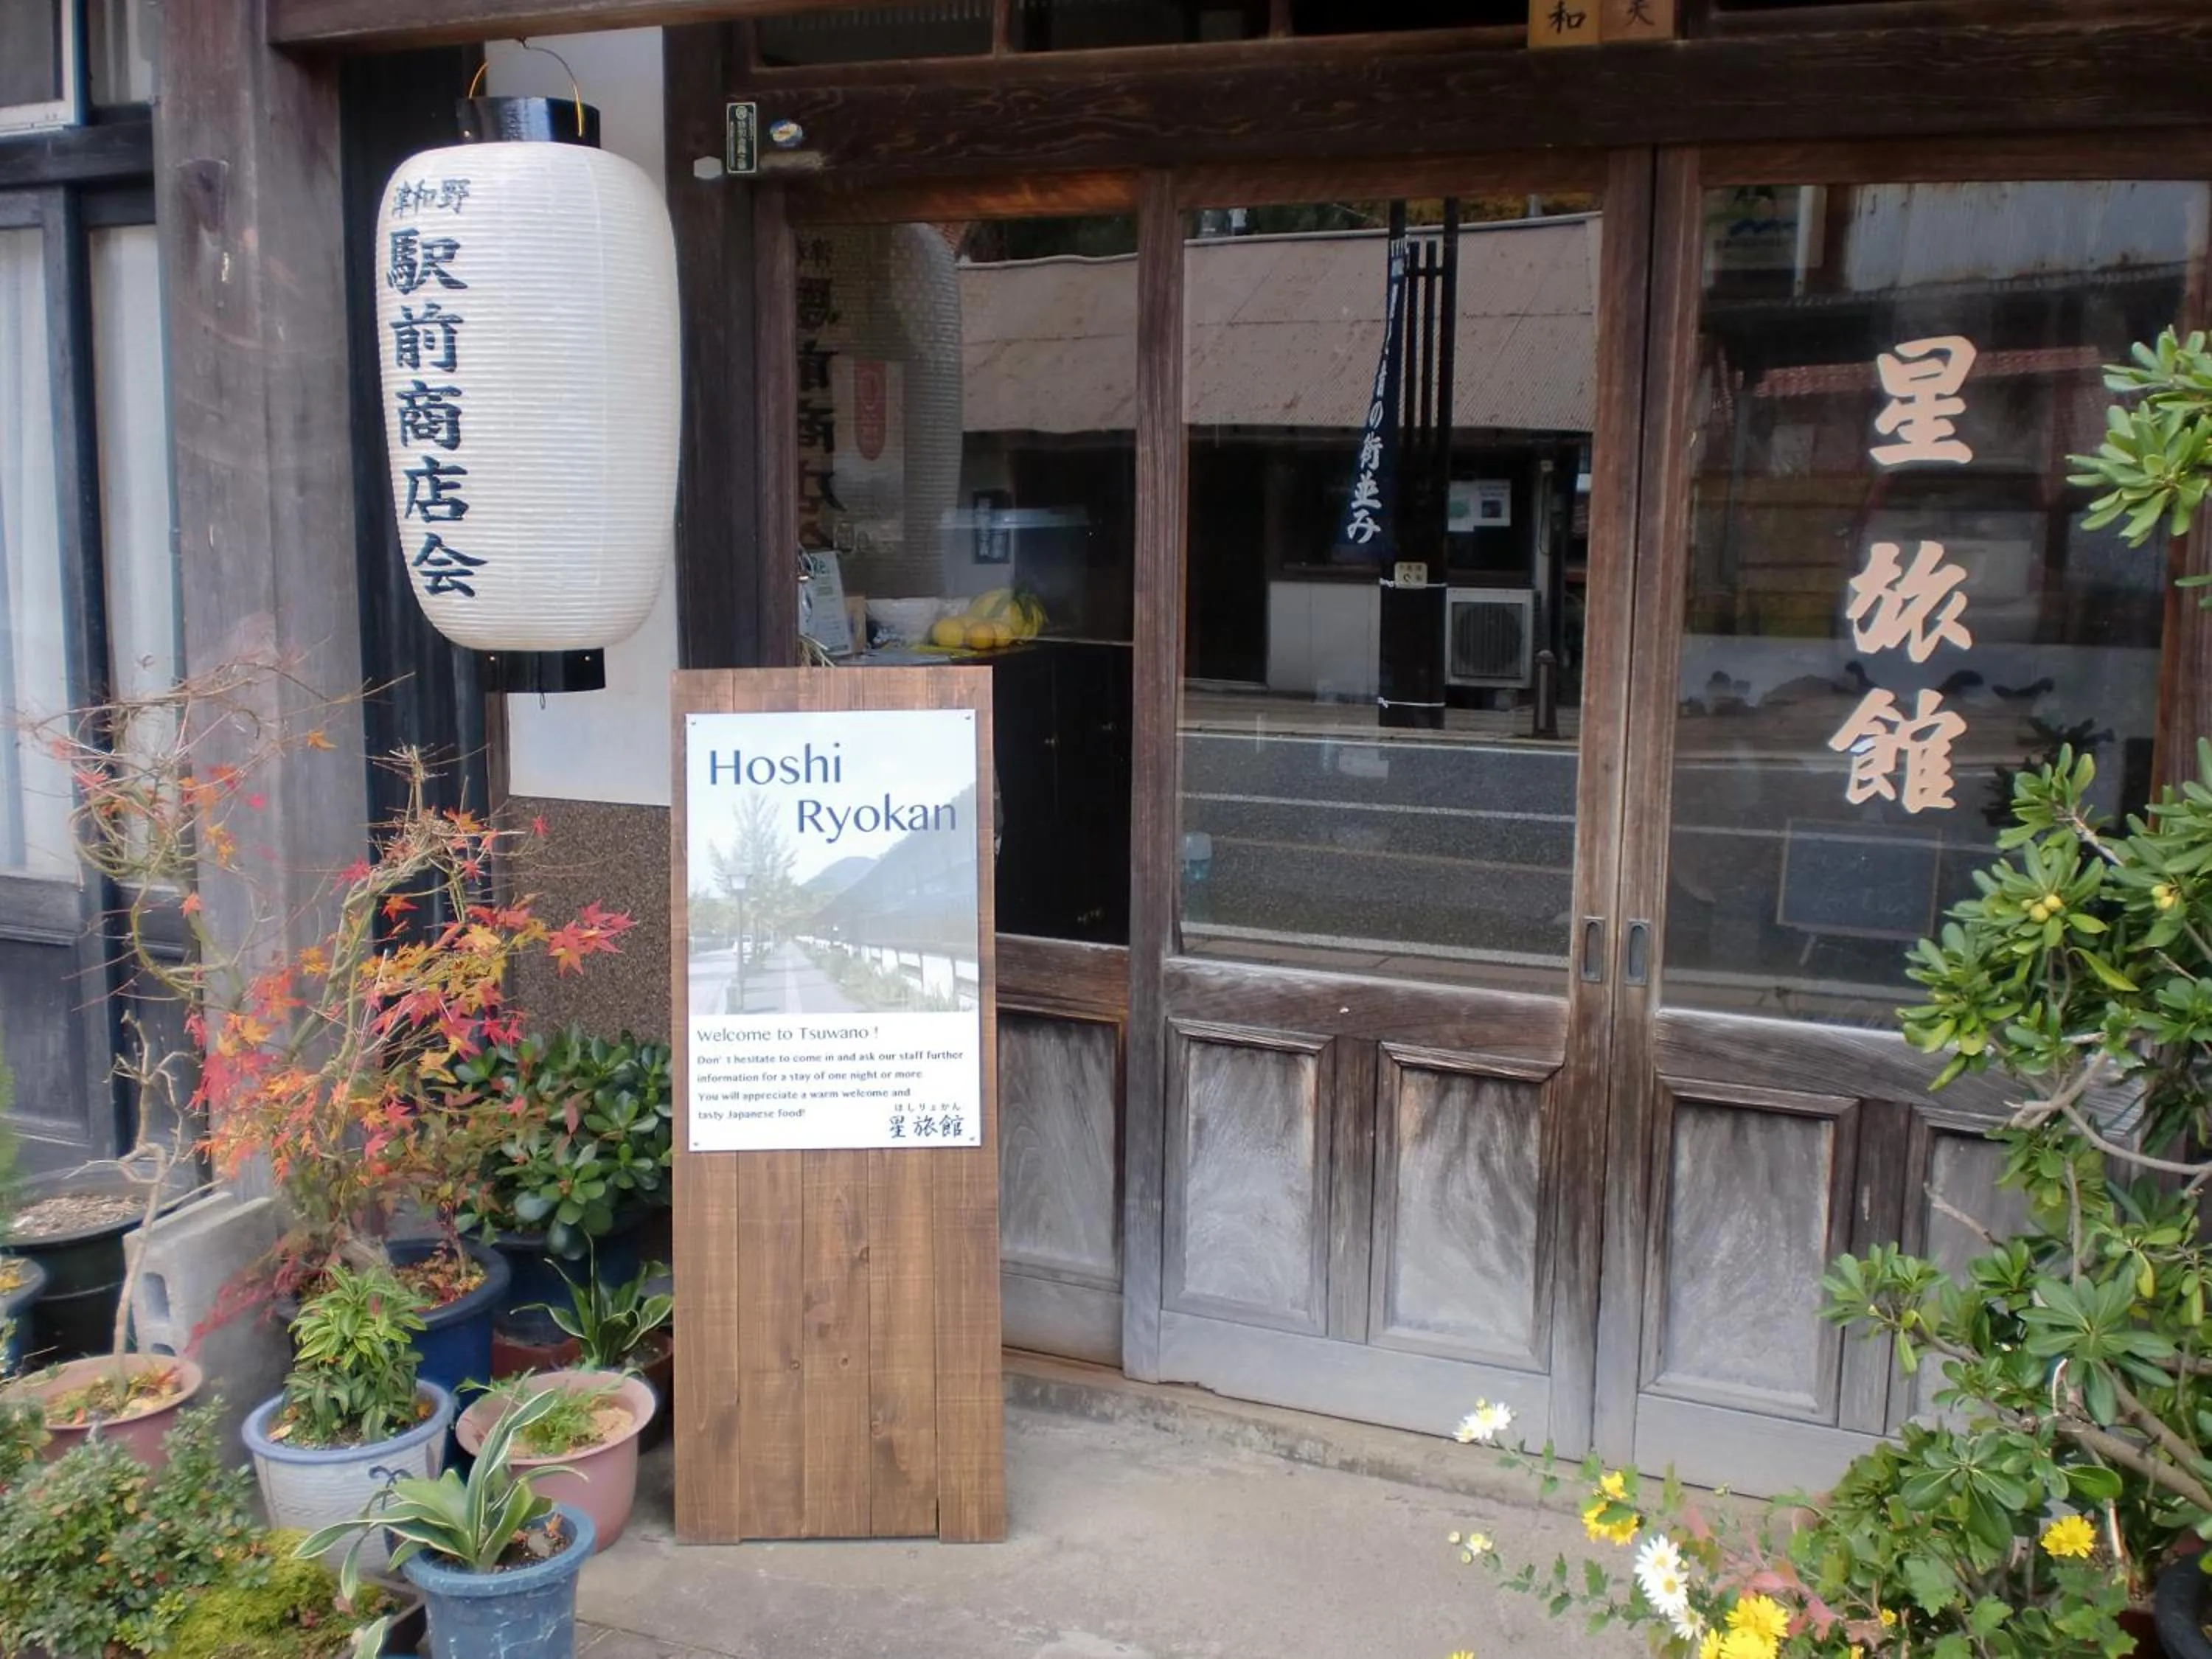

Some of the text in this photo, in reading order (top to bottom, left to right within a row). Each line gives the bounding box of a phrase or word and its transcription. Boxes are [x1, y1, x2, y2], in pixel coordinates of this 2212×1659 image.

[386, 227, 488, 598] 駅前商店会
[1829, 335, 1978, 813] 星旅館
[710, 742, 841, 785] Hoshi
[798, 793, 956, 844] Ryokan
[697, 1026, 771, 1042] Welcome
[777, 1029, 793, 1040] to
[799, 1026, 869, 1040] Tsuwano
[734, 1054, 775, 1065] hesitate
[779, 1054, 790, 1063] to
[837, 1052, 856, 1061] and
[859, 1052, 875, 1061] ask
[900, 1051, 923, 1060] staff
[926, 1050, 963, 1060] further
[697, 1073, 759, 1083] information
[762, 1071, 778, 1081] for
[790, 1073, 811, 1083] stay
[813, 1071, 826, 1080] of
[850, 1071, 877, 1082] night
[698, 1092, 719, 1102] You
[722, 1091, 740, 1100] will
[742, 1090, 798, 1102] appreciate
[842, 1089, 888, 1099] welcome
[891, 1088, 911, 1097] and
[698, 1111, 724, 1121] tasty
[728, 1110, 775, 1121] Japanese
[889, 1114, 964, 1138] 星旅館
